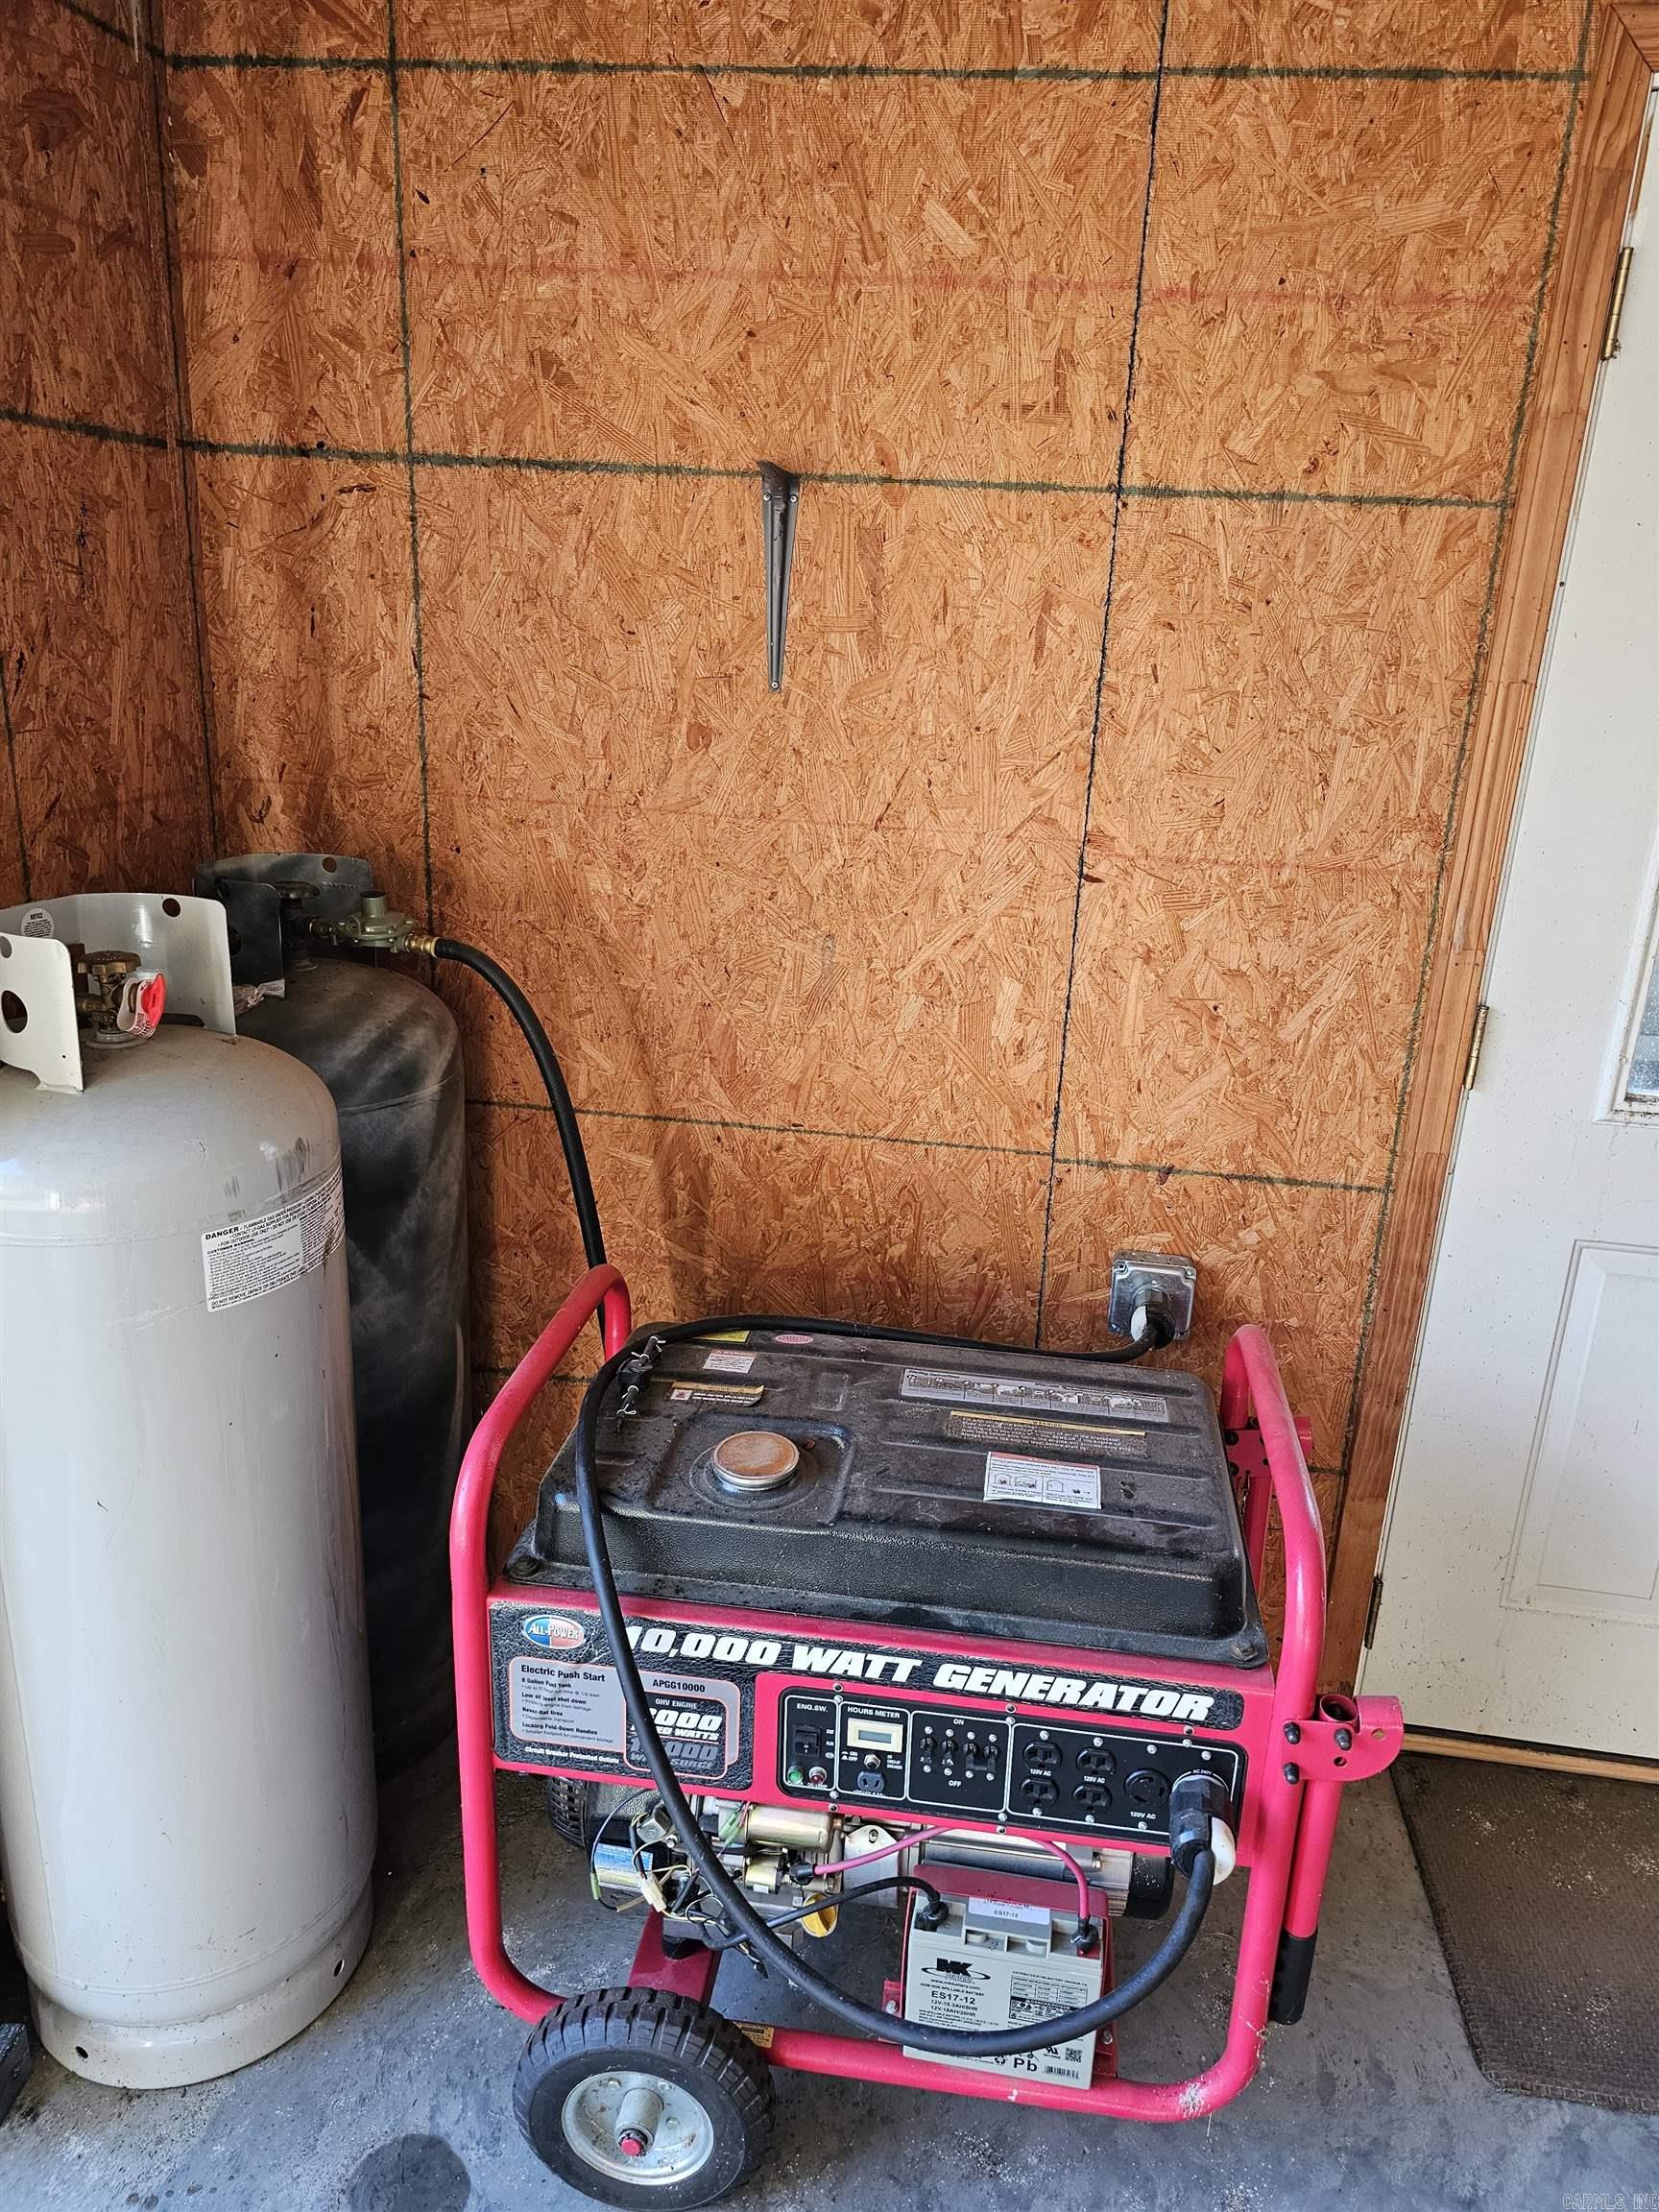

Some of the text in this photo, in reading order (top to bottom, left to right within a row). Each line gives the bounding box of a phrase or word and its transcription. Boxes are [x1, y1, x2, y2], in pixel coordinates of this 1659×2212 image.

[205, 1226, 239, 1240] DANGER
[530, 1623, 581, 1640] ALL-POWER
[520, 1664, 606, 1682] Electric Push Start
[626, 1626, 1214, 1721] 10,000 WATT GENERATOR
[652, 1679, 706, 1693] APGG10000
[672, 1700, 699, 1709] ENGINE
[848, 1706, 901, 1719] HOURS METER
[674, 1728, 719, 1741] WATTS
[545, 1748, 569, 1757] Breaker
[569, 1752, 597, 1761] Protected
[598, 1755, 620, 1764] Outlets
[994, 1910, 1019, 1918] ES17-12
[937, 1958, 974, 1978] MK
[931, 1990, 976, 2006] ES17-12
[1014, 2056, 1038, 2072] Pb
